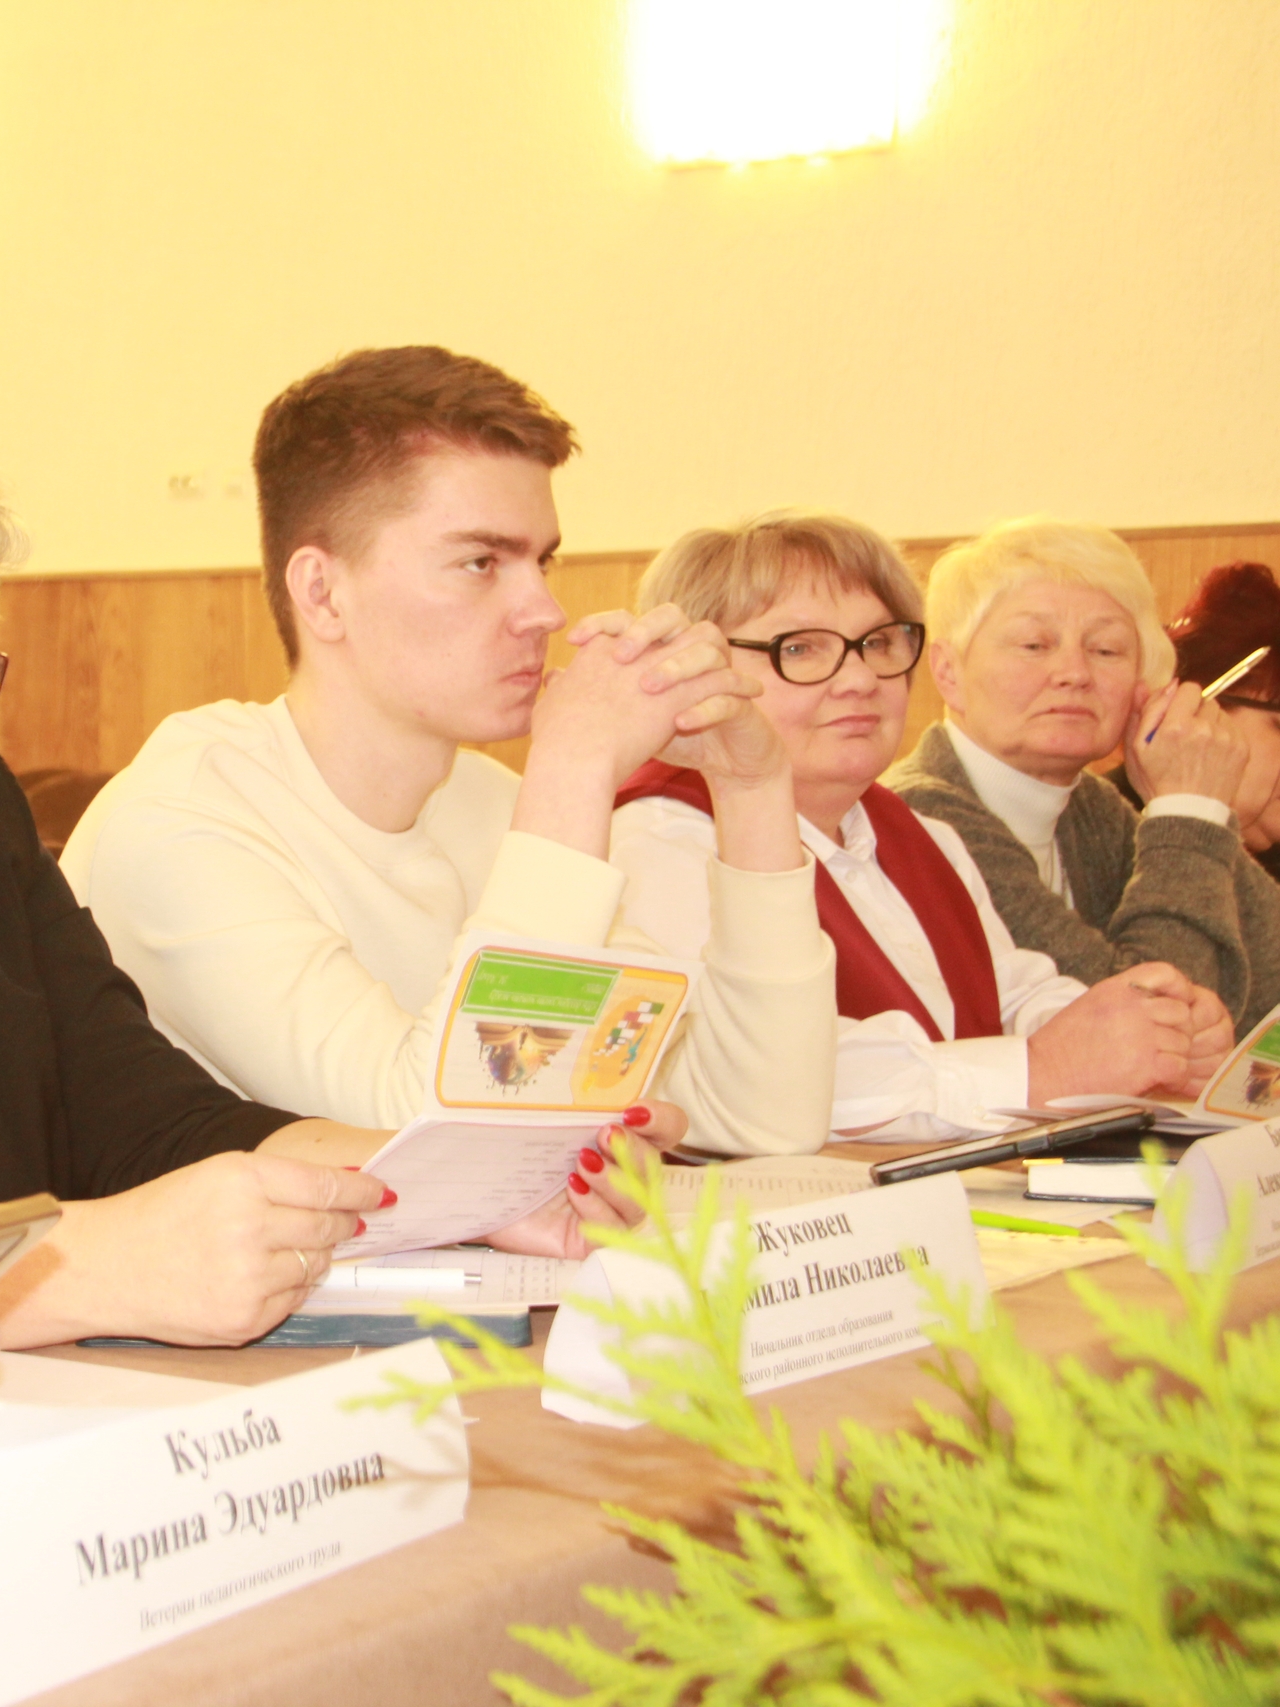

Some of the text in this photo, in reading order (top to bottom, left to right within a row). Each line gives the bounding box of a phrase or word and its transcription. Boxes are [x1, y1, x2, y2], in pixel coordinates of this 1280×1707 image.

[748, 1211, 854, 1257] Жуковец
[750, 1309, 894, 1358] Начальник отдела образования
[773, 1352, 824, 1380] районного
[825, 1330, 903, 1362] исполнительного
[164, 1408, 282, 1480] Кульба
[74, 1452, 386, 1586] Марина Эдуардовна
[139, 1541, 341, 1631] Ветеран педагогического труда
